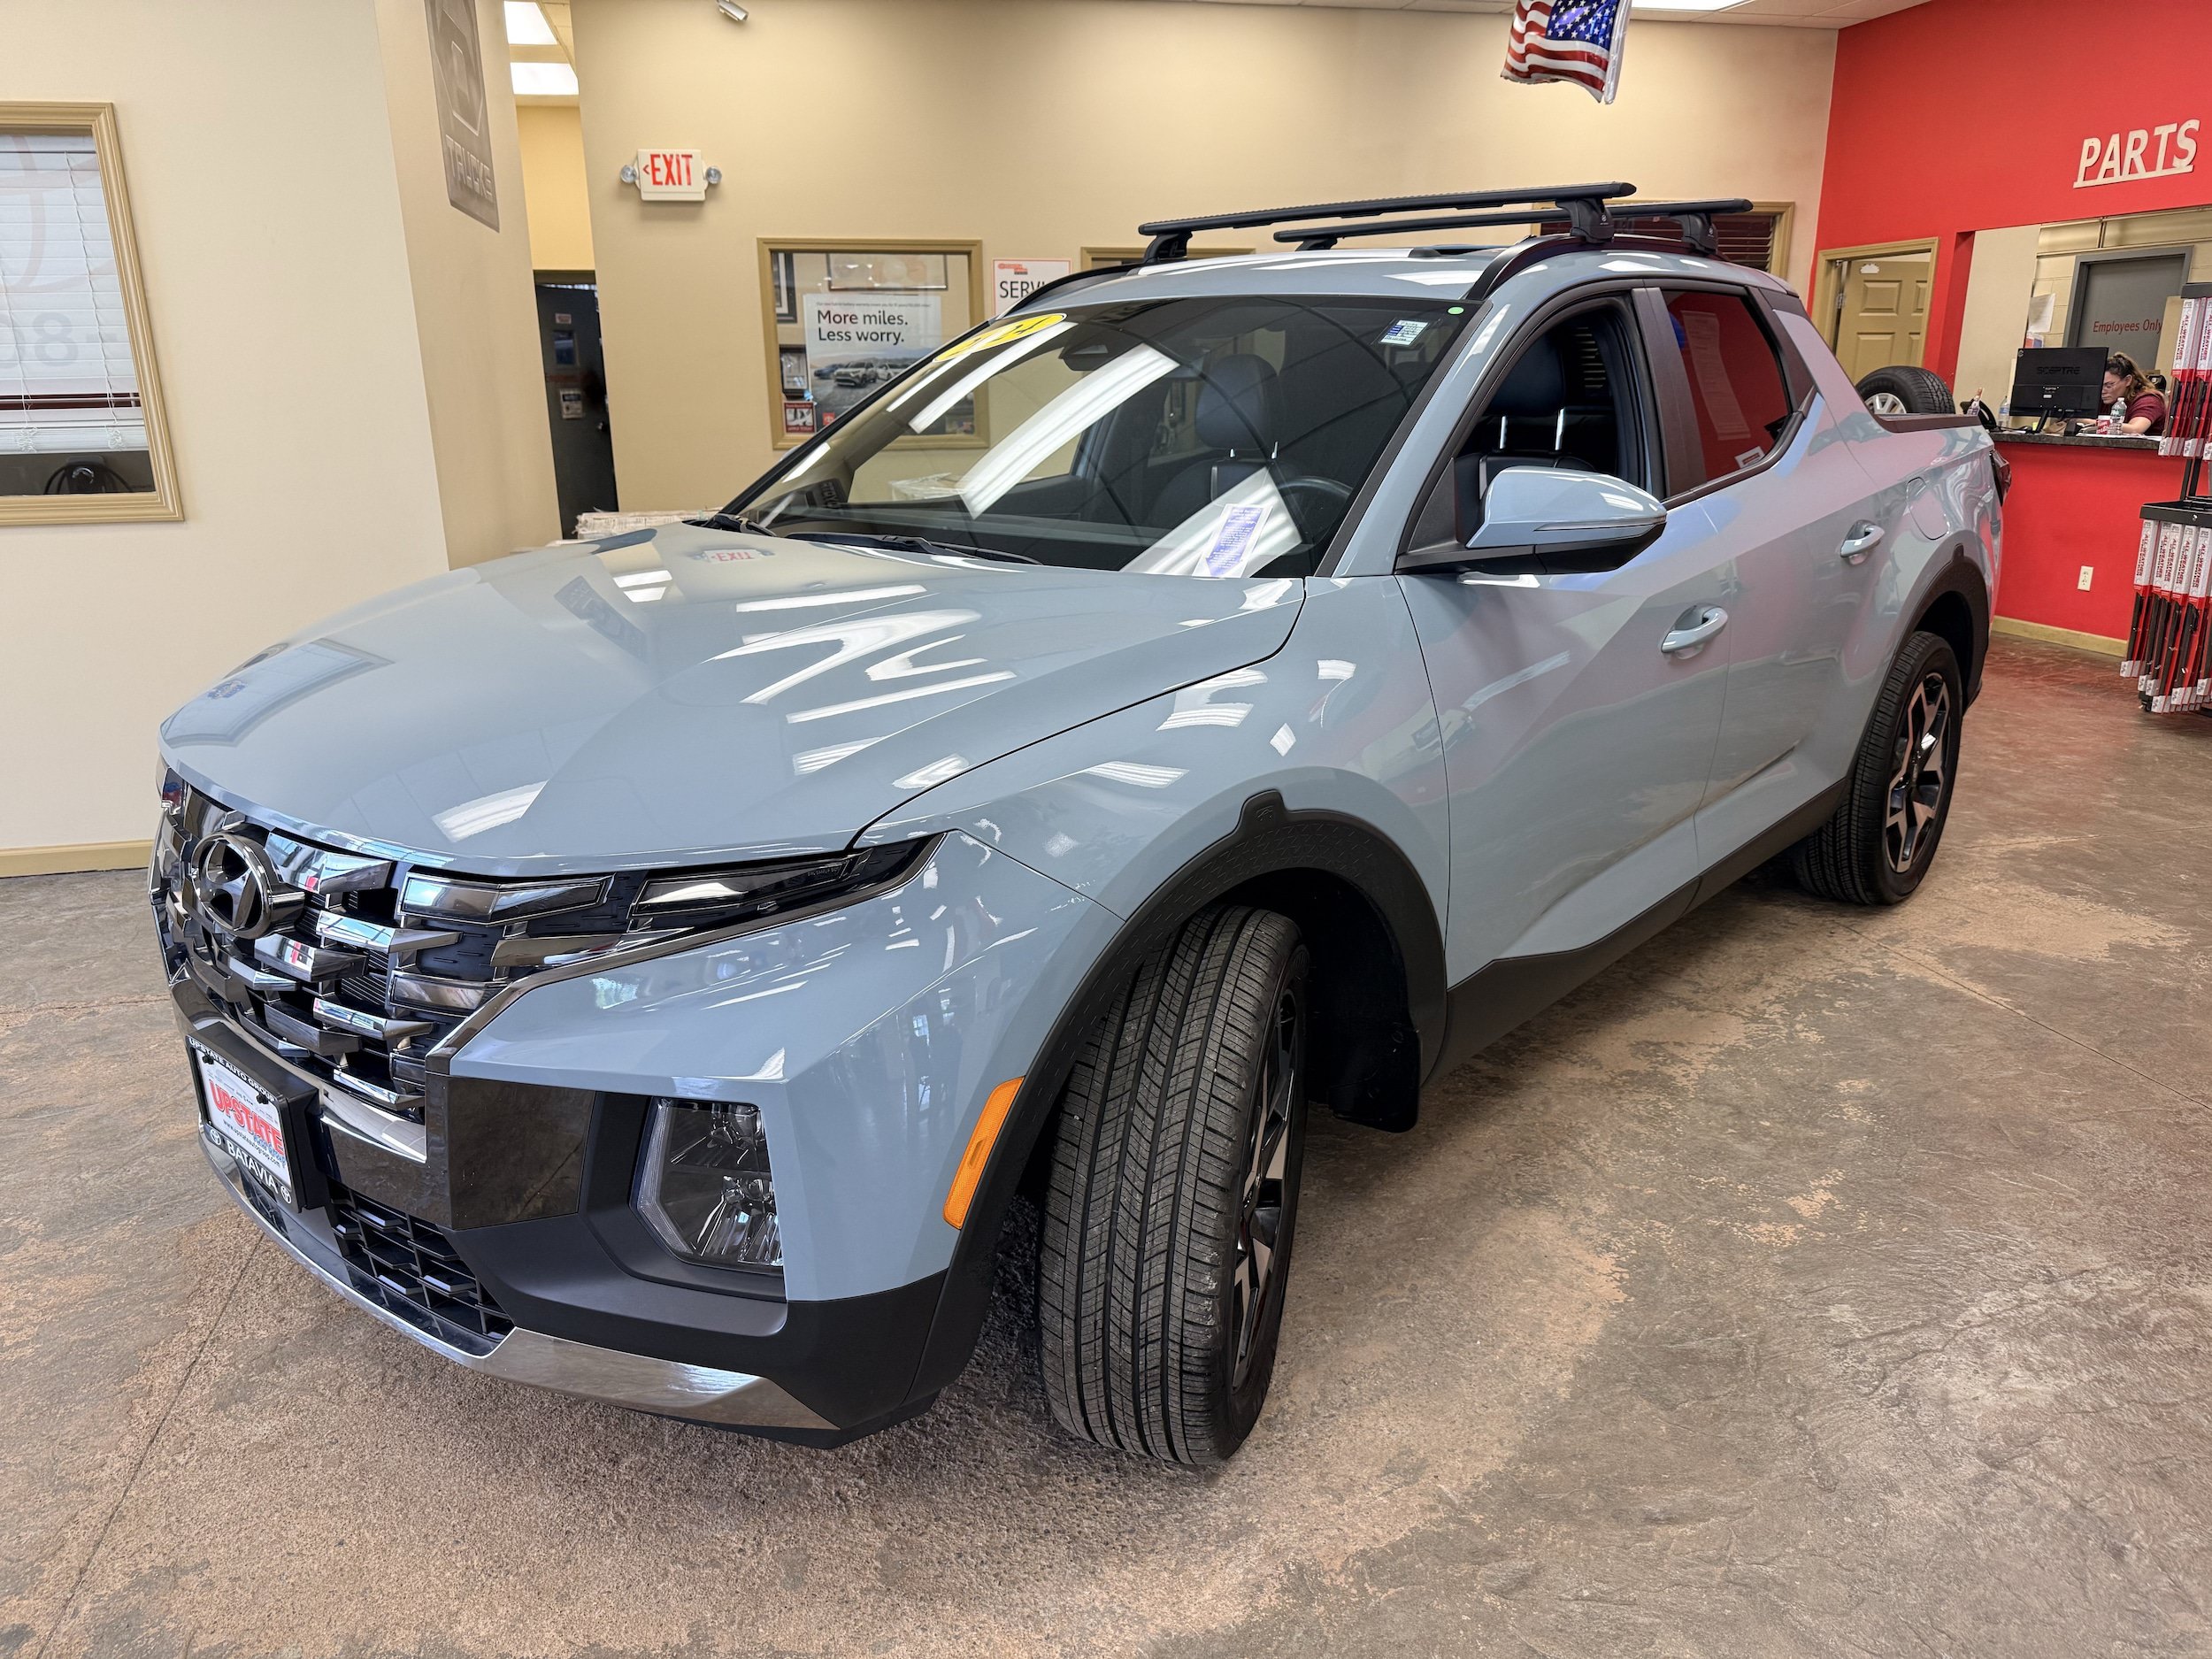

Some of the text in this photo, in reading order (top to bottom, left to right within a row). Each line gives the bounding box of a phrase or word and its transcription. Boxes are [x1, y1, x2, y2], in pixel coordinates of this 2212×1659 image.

[649, 153, 693, 186] EXIT
[2074, 119, 2200, 188] PARTS
[817, 310, 909, 326] More miles.
[818, 326, 905, 346] Less worry.
[2093, 319, 2162, 335] Employees Only
[2178, 314, 2190, 360] ALL-WEATHER
[2037, 366, 2080, 375] SCEPTRE
[2138, 534, 2149, 577] ALL-WEATHER
[2158, 534, 2168, 578] ALL-WEATHER
[2167, 538, 2177, 582] ALL-WEATHER
[2179, 540, 2191, 585] ALL-WEATHER
[2194, 543, 2206, 588] ALL-WEATHER
[188, 1037, 226, 1066] UPSTATE
[225, 1061, 248, 1081] AUTO
[248, 1076, 276, 1102] GROUP
[208, 1079, 284, 1156] UPSTATE
[227, 1140, 279, 1194] BATAVIA
